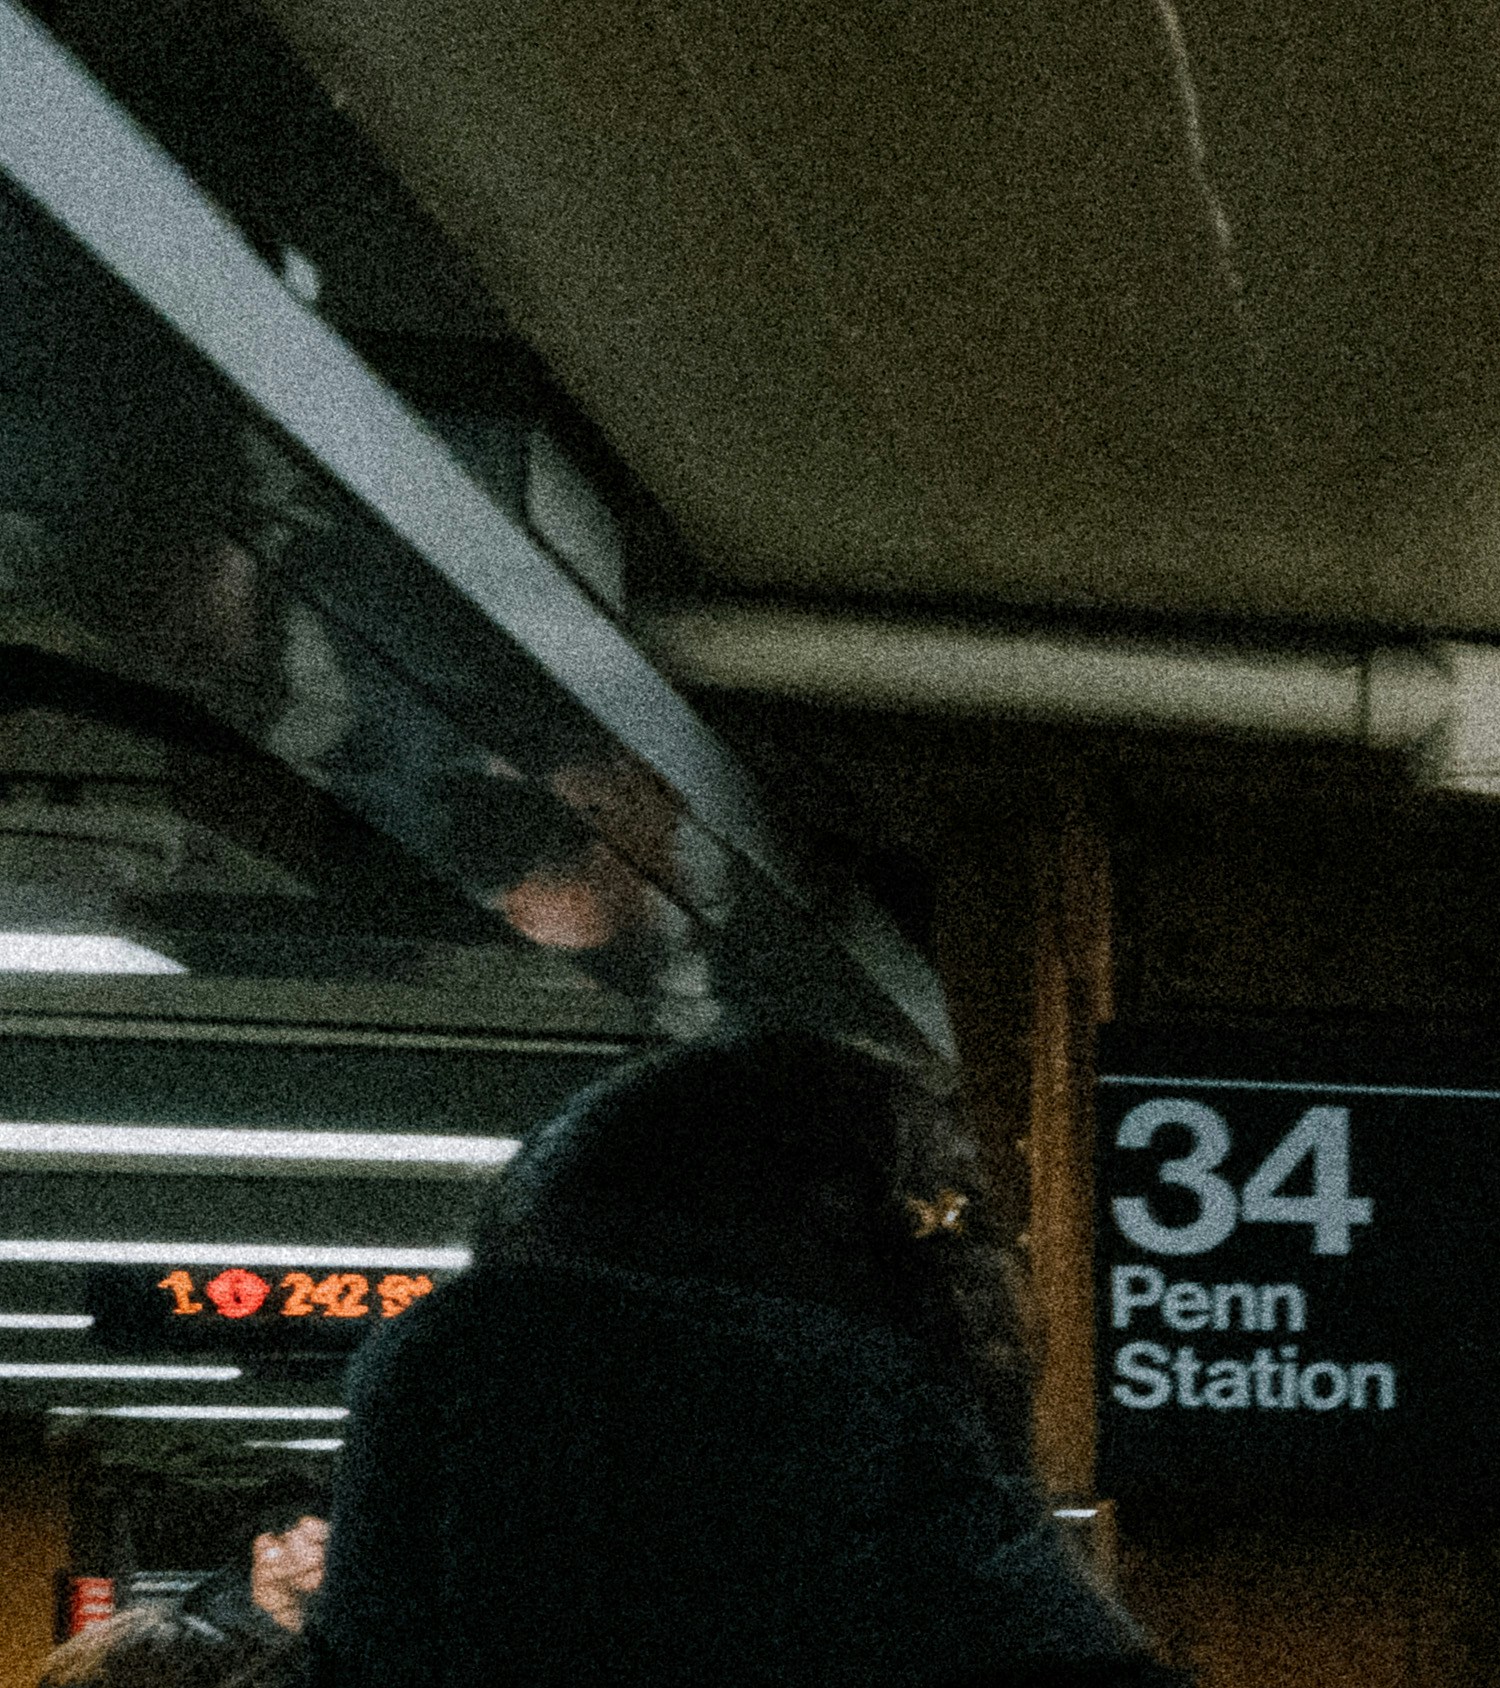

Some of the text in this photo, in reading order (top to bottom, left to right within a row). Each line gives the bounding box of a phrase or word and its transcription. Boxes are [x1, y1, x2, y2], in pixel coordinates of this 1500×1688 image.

[1111, 1098, 1374, 1256] 34
[280, 1272, 369, 1319] 242
[1111, 1264, 1306, 1331] Penn
[1112, 1340, 1397, 1410] Station
